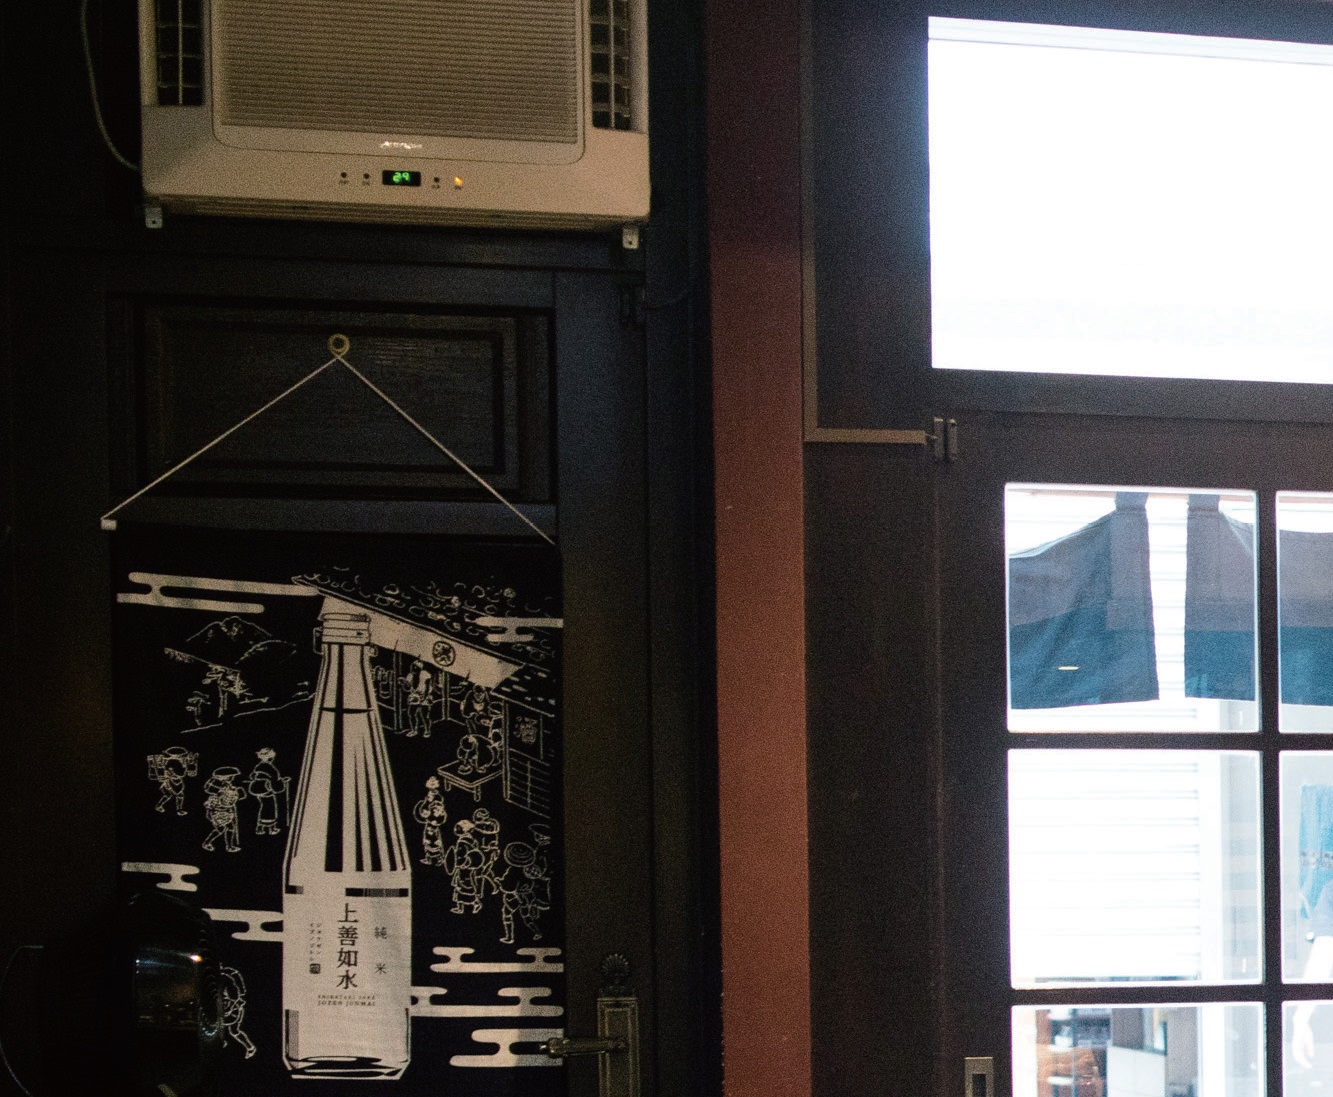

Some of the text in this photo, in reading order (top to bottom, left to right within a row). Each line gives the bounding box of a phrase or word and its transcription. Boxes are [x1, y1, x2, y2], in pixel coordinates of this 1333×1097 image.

[392, 171, 411, 184] 29
[336, 903, 359, 990] 上善如水
[374, 926, 388, 975] 純米
